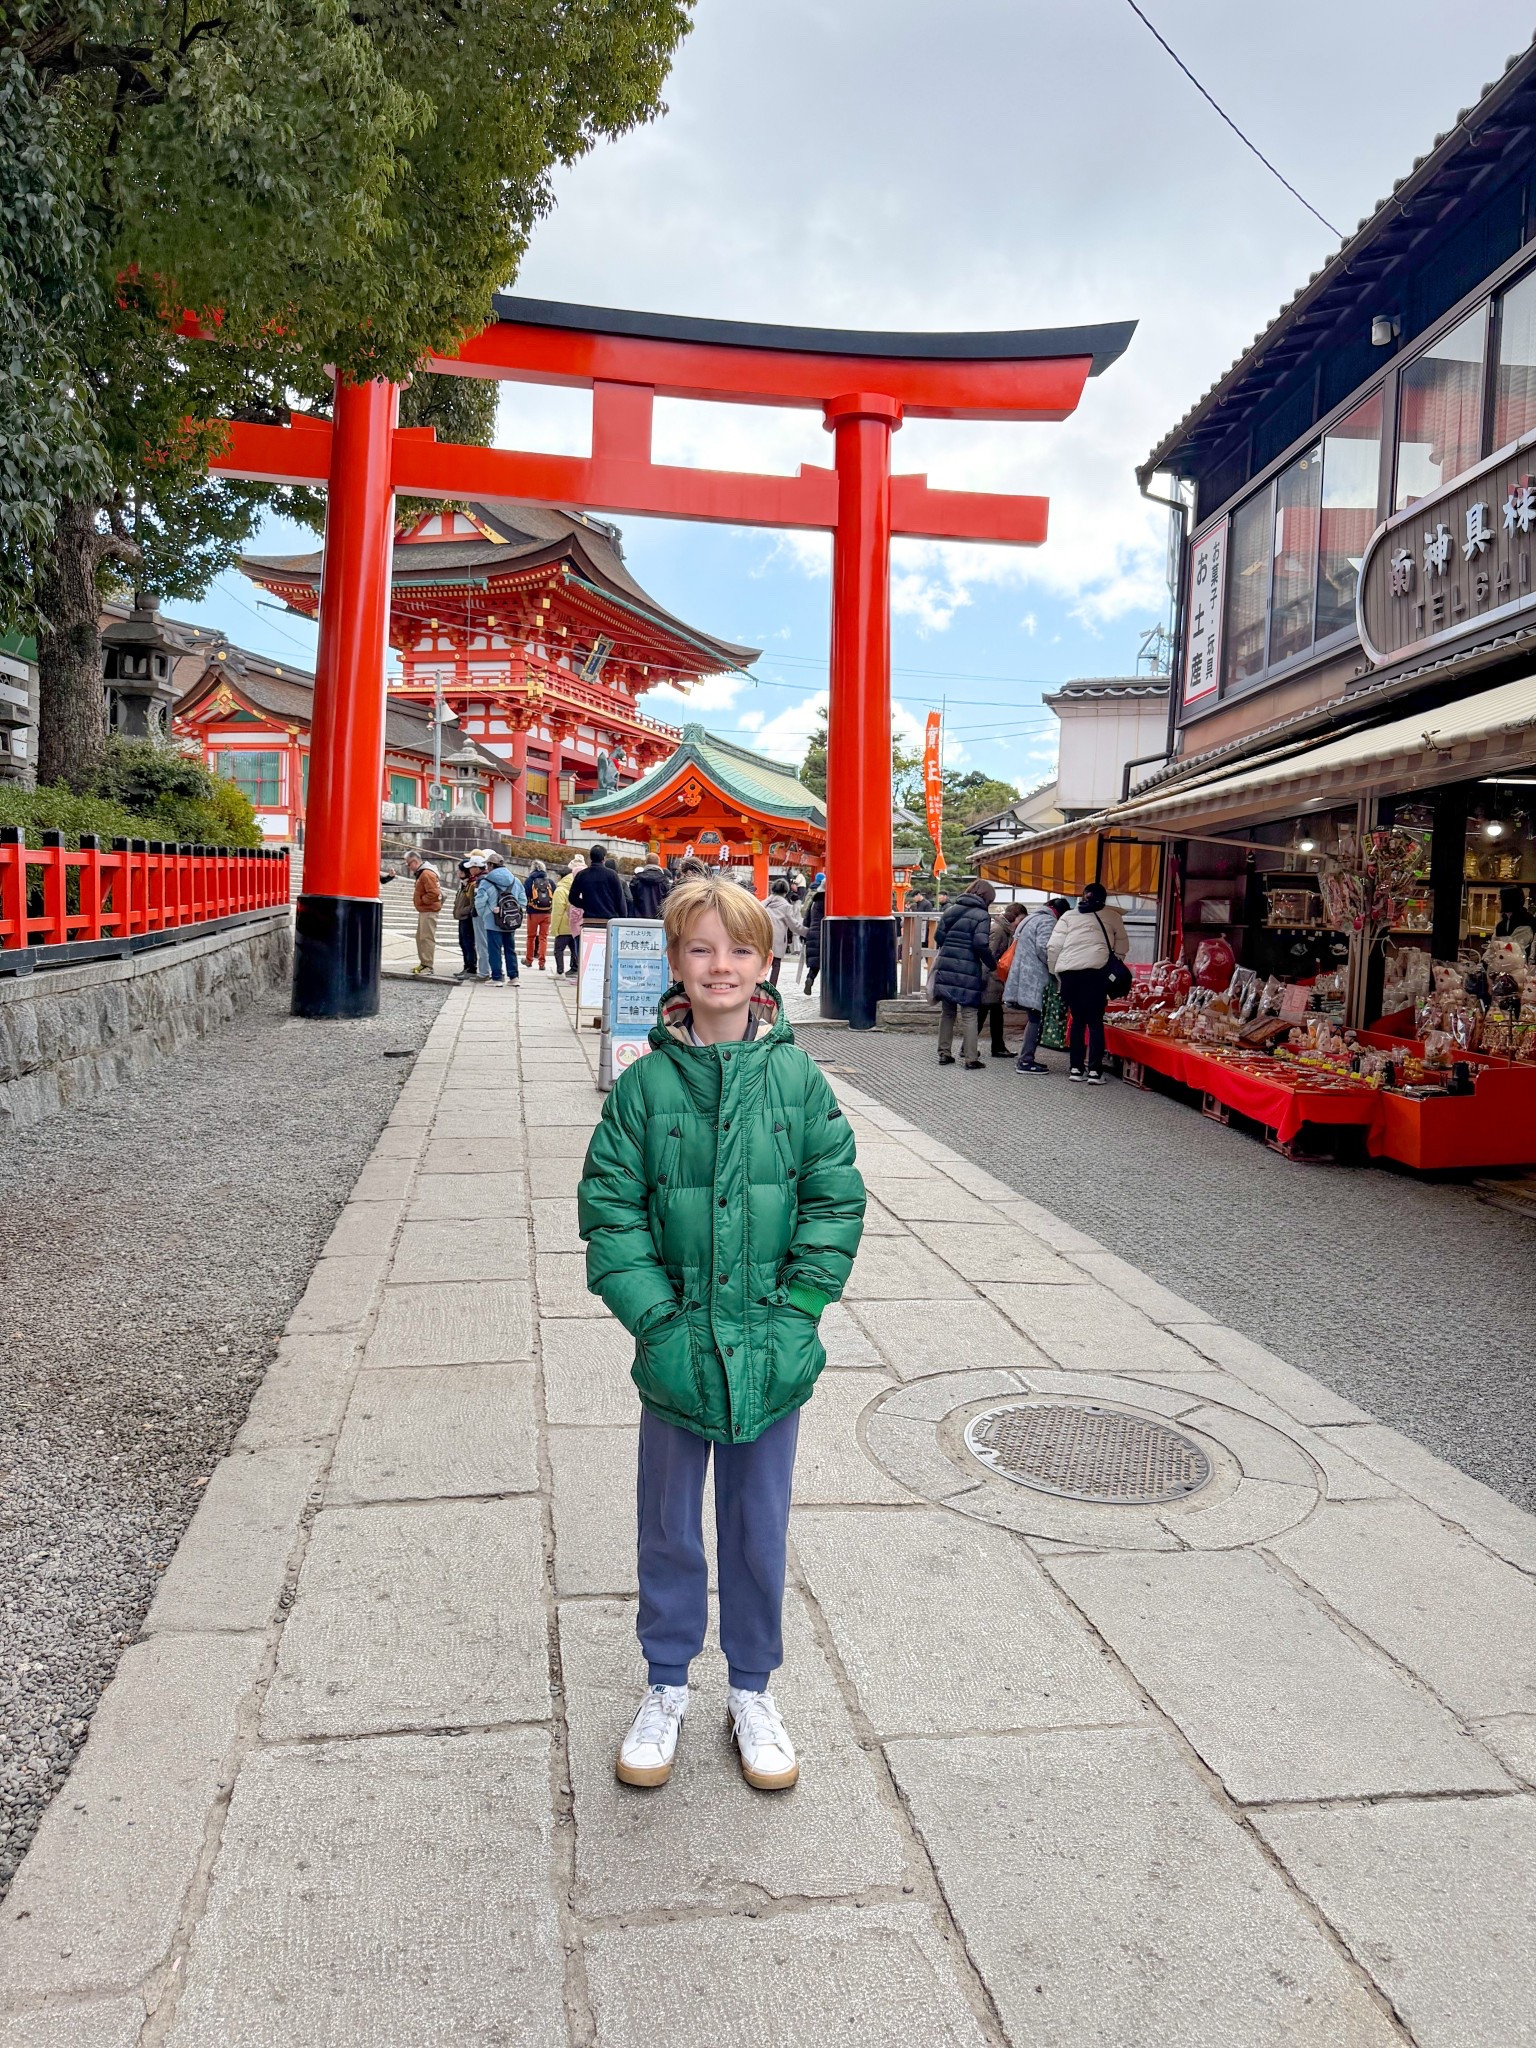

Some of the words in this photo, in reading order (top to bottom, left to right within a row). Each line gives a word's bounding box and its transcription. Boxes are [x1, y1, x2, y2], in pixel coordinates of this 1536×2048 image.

[1190, 552, 1208, 687] お土産
[620, 940, 660, 951] 飲食禁止
[619, 1006, 658, 1016] 二輪下車
